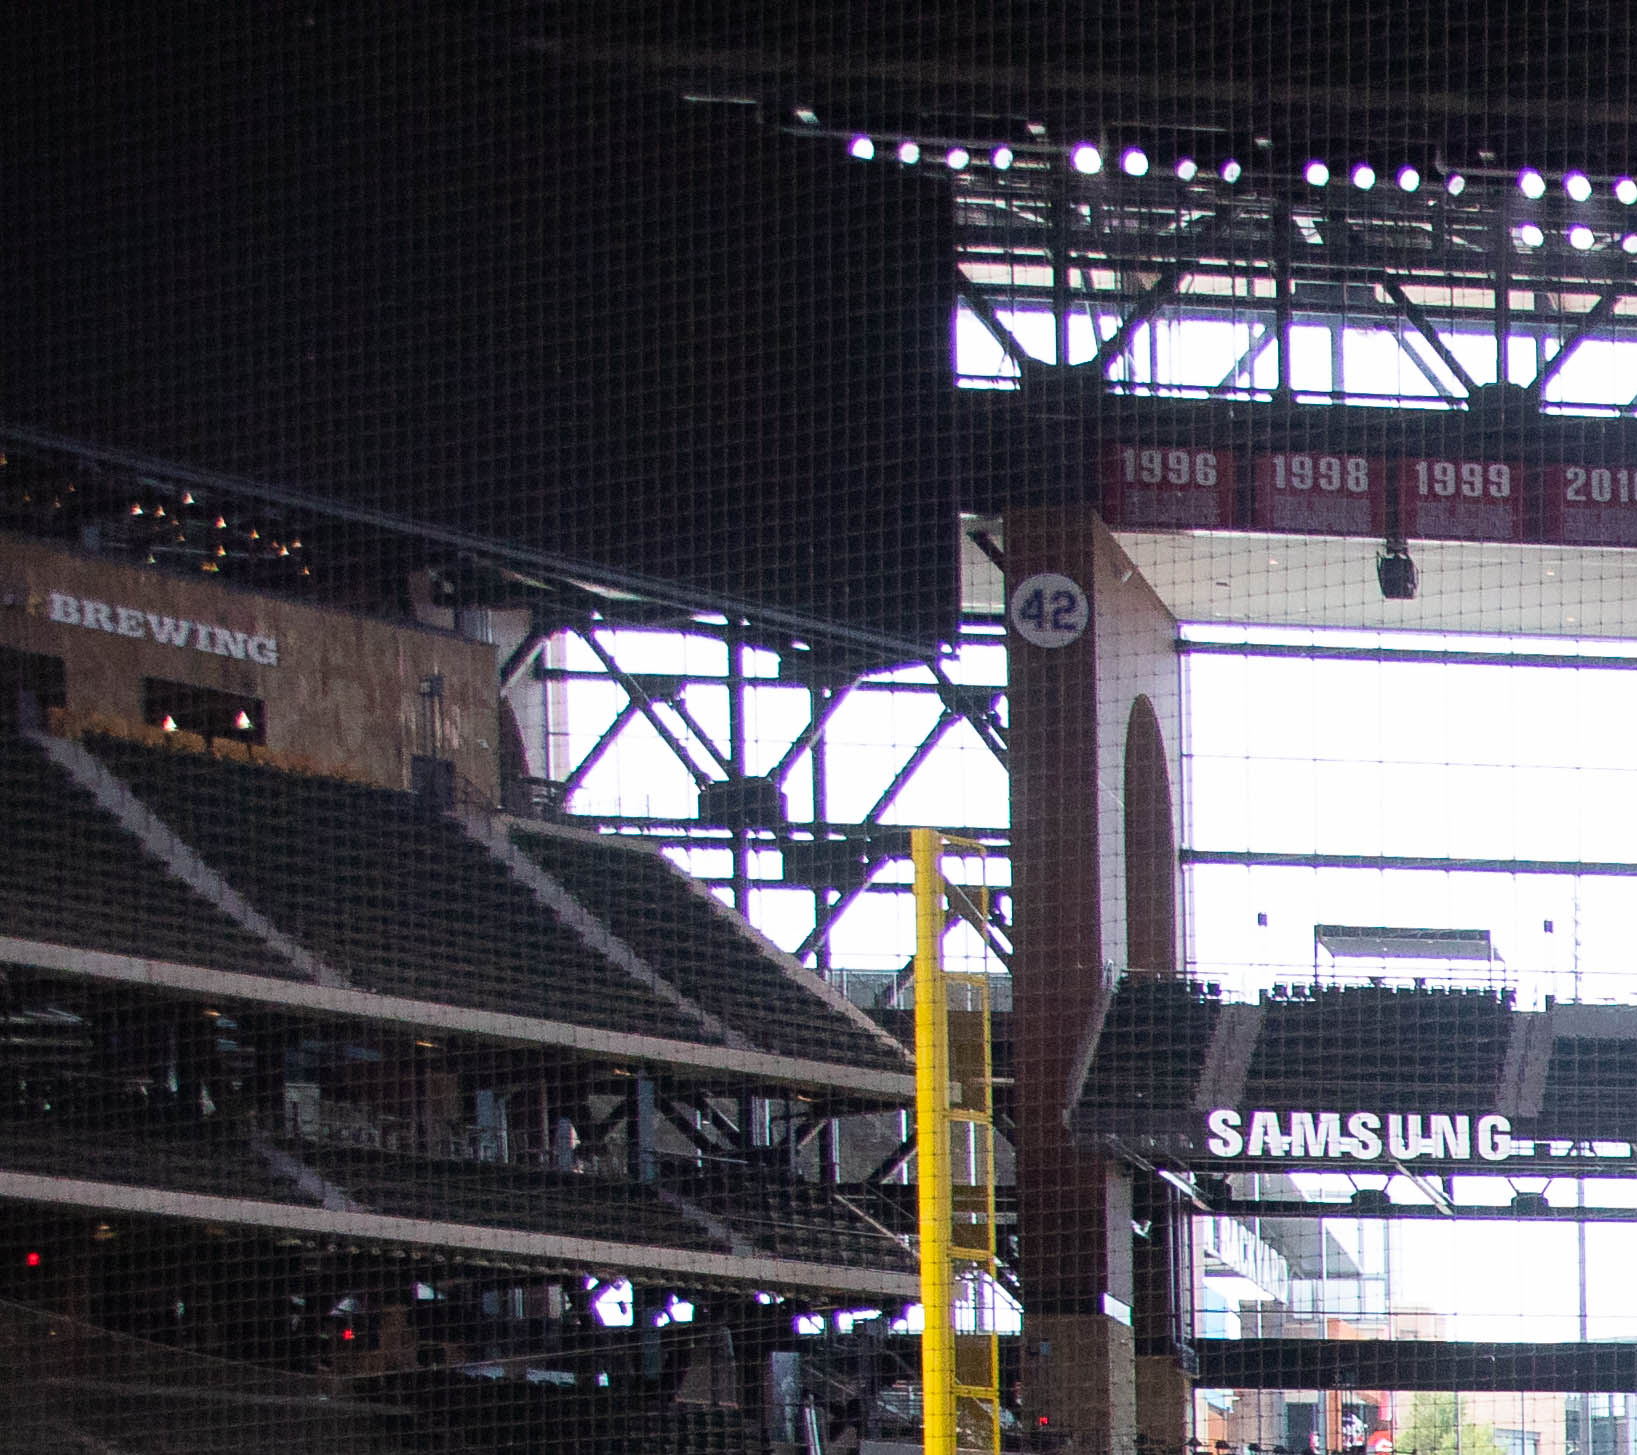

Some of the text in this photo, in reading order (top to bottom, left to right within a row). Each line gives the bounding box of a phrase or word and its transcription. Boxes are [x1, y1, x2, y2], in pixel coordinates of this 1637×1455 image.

[1121, 449, 1218, 486] 1996
[1272, 454, 1370, 492] 1998
[1415, 461, 1511, 498] 1999
[50, 590, 279, 667] BREWING
[1019, 587, 1078, 633] 42
[1207, 1110, 1513, 1161] SAMSUNG
